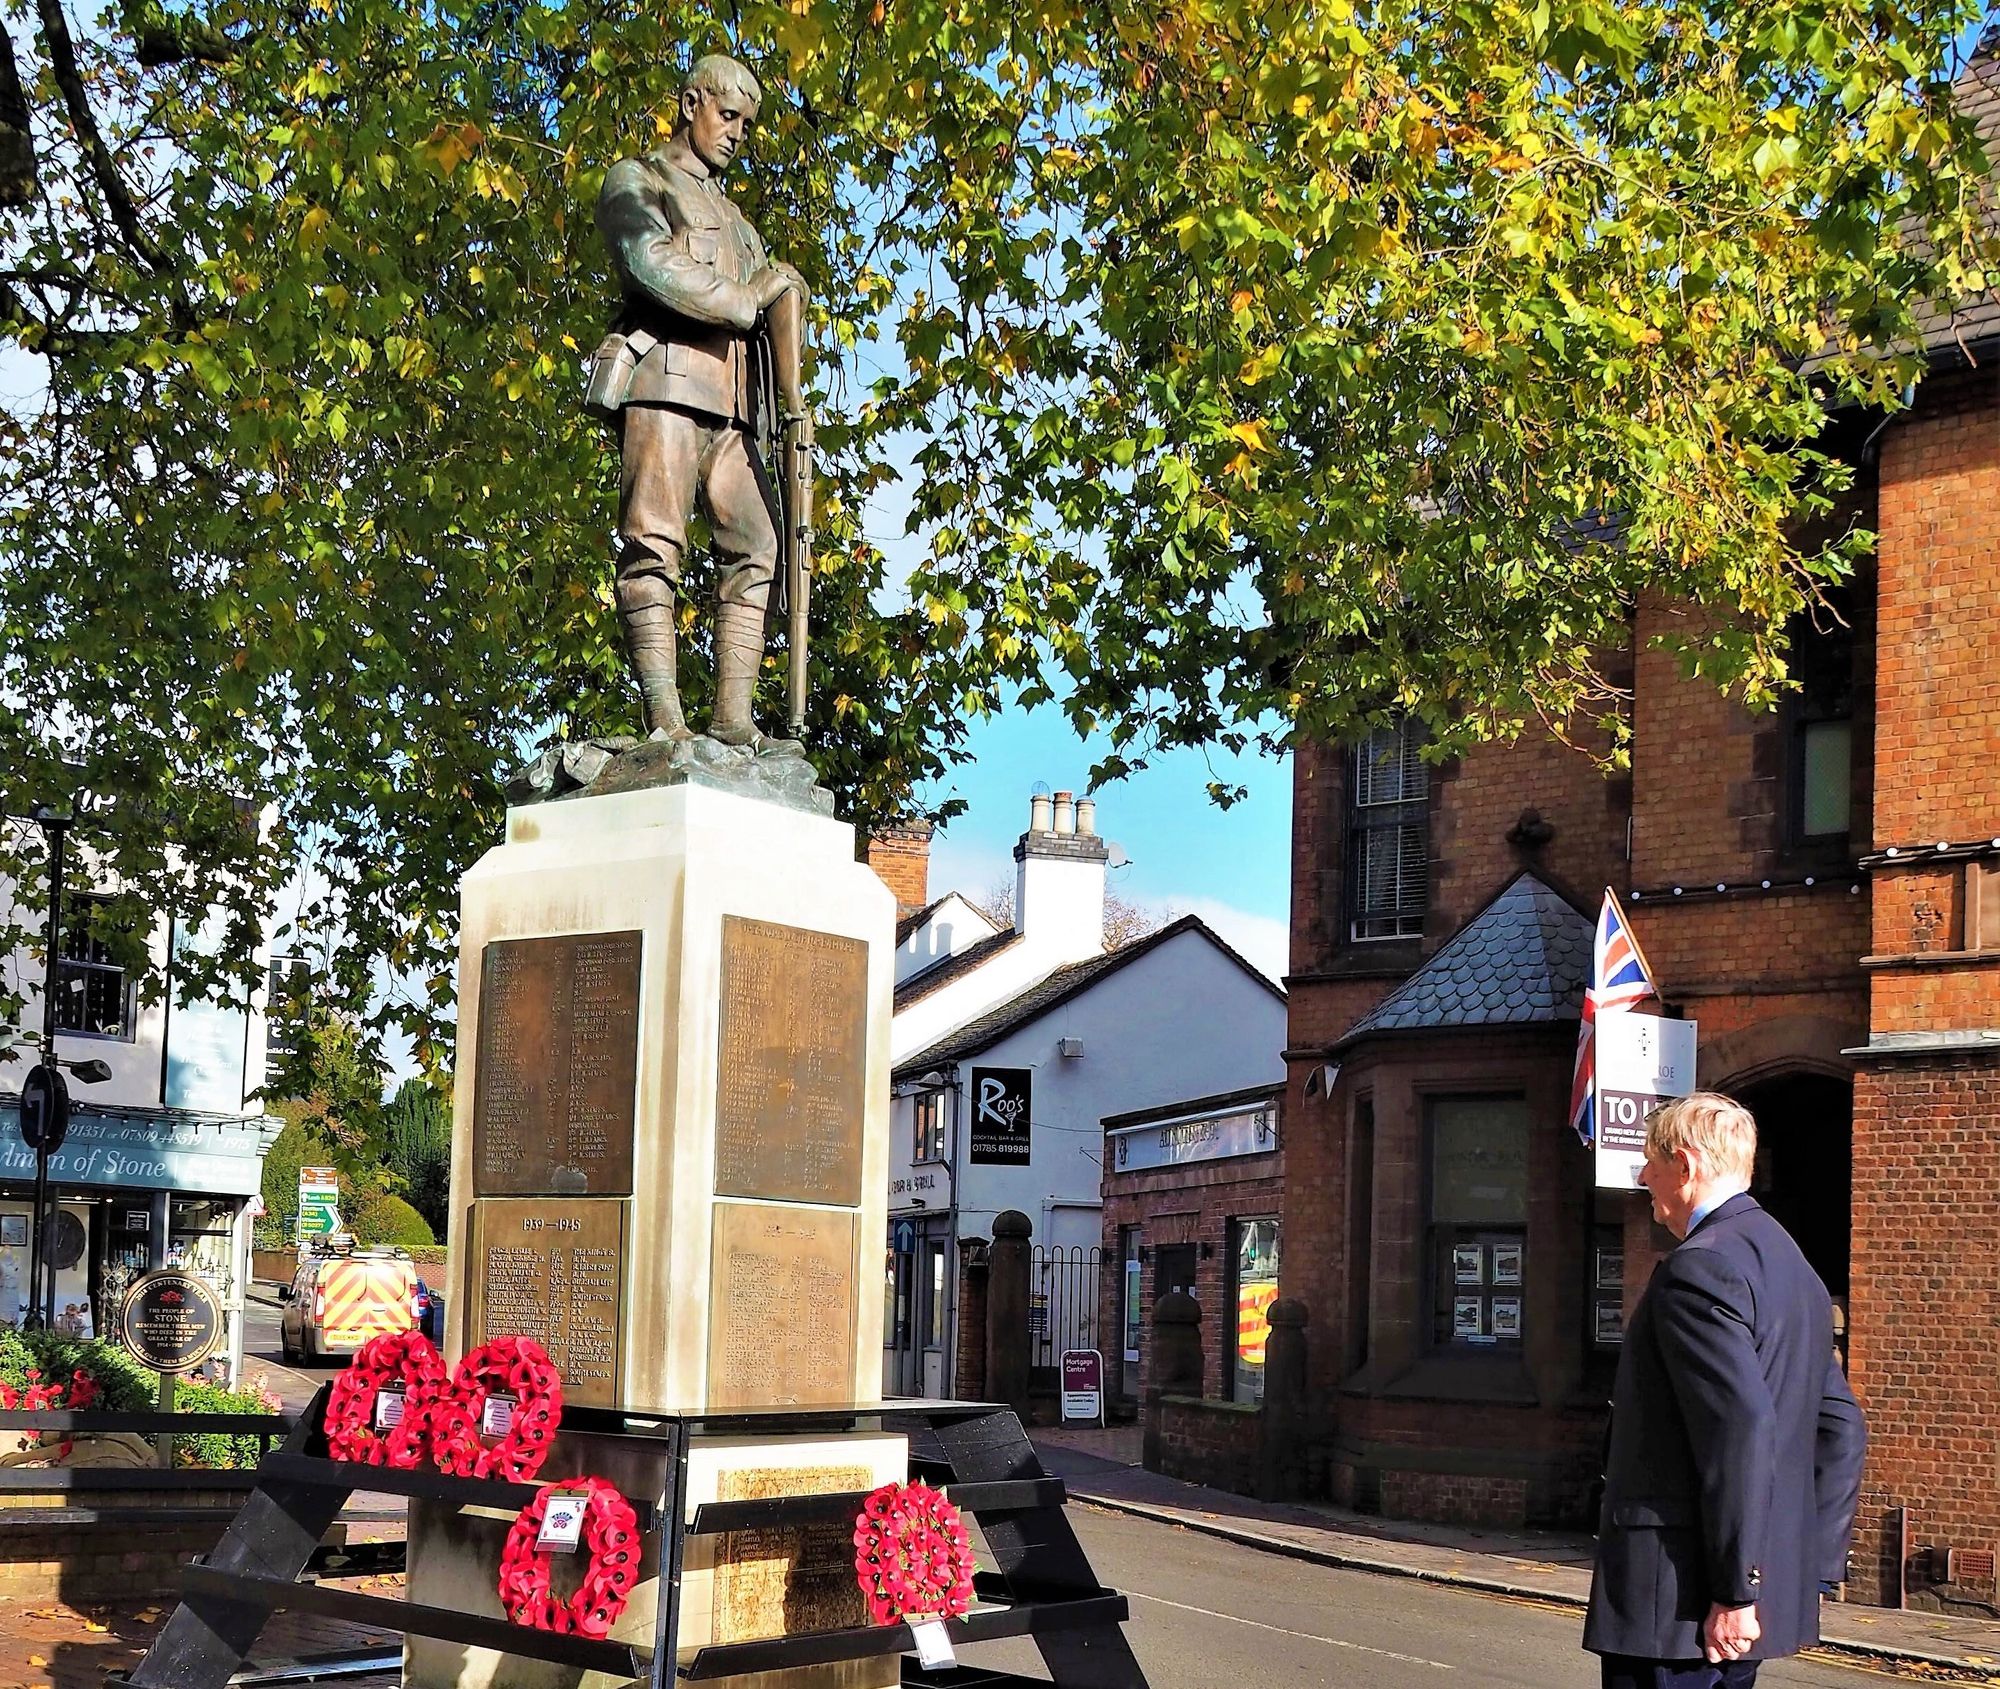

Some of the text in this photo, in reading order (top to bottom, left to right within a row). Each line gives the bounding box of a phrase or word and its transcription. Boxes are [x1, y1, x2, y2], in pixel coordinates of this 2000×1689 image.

[1603, 1096, 1637, 1125] TO
[66, 1123, 107, 1139] 91351
[972, 1144, 1029, 1153] 01785 819988
[0, 1143, 66, 1170] dmn
[73, 1148, 102, 1179] of
[102, 1150, 166, 1178] Stone
[523, 1218, 544, 1231] 1939
[558, 1218, 581, 1231] 1945
[154, 1314, 187, 1322] STONE
